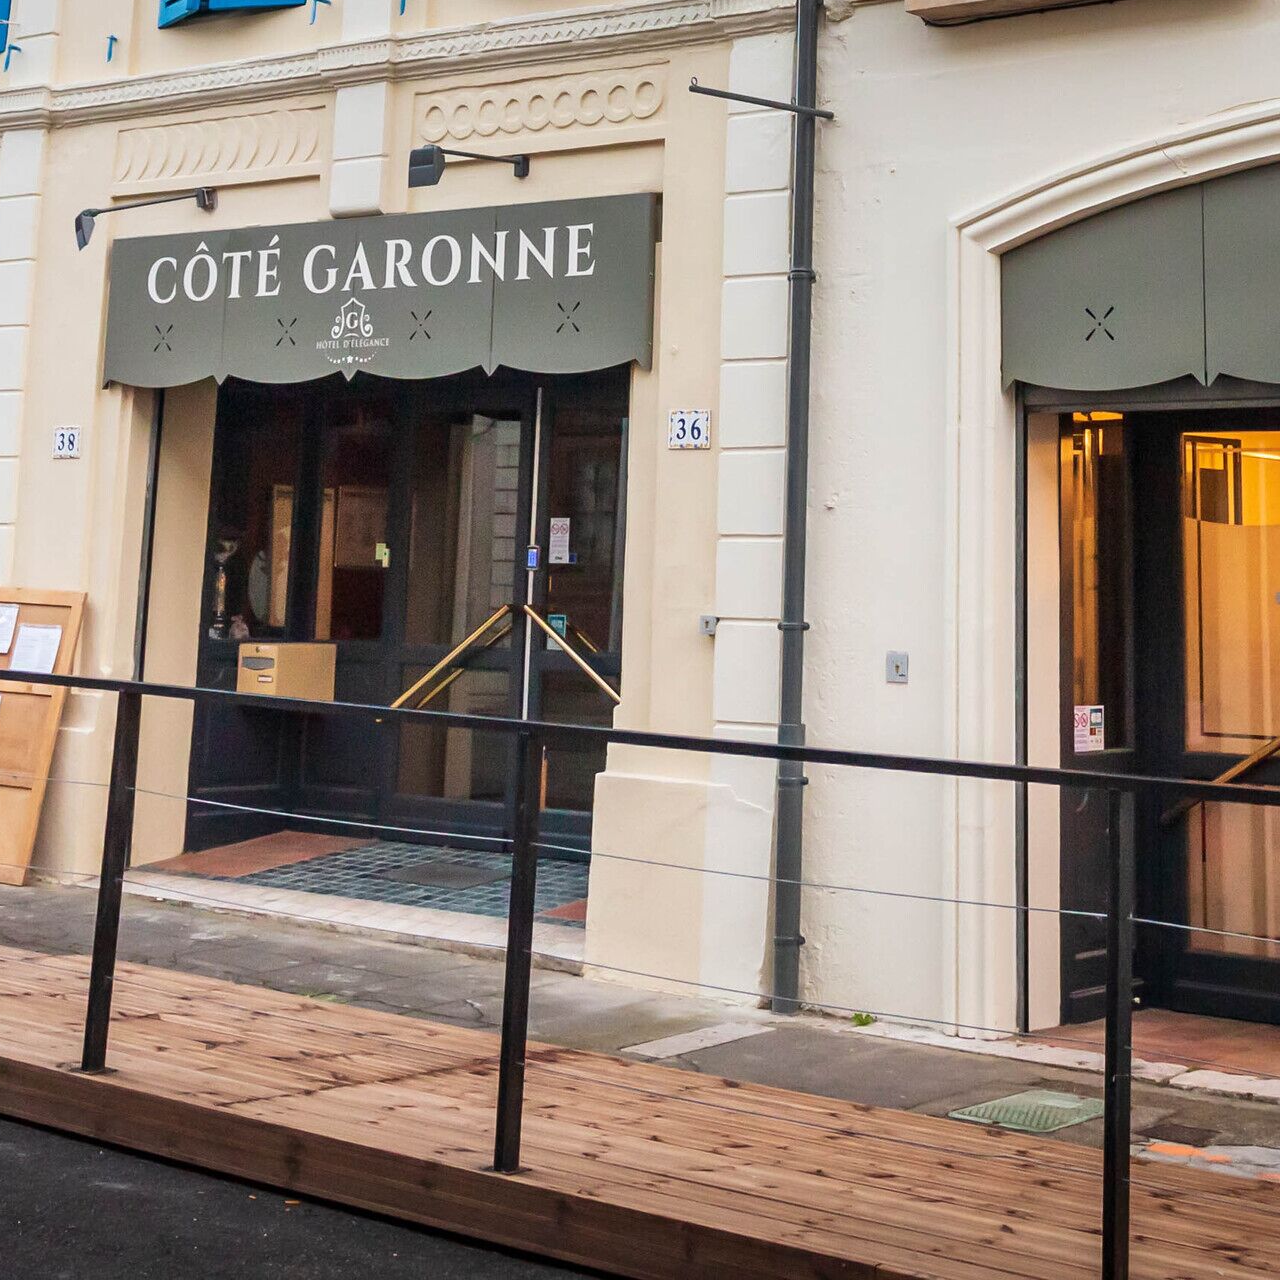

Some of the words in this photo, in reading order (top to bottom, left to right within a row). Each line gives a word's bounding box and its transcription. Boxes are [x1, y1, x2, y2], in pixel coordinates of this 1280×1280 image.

[147, 234, 281, 304] CÔTÉ
[302, 223, 596, 294] GARONNE
[346, 312, 358, 329] G
[676, 418, 701, 440] 36
[58, 433, 75, 451] 38
